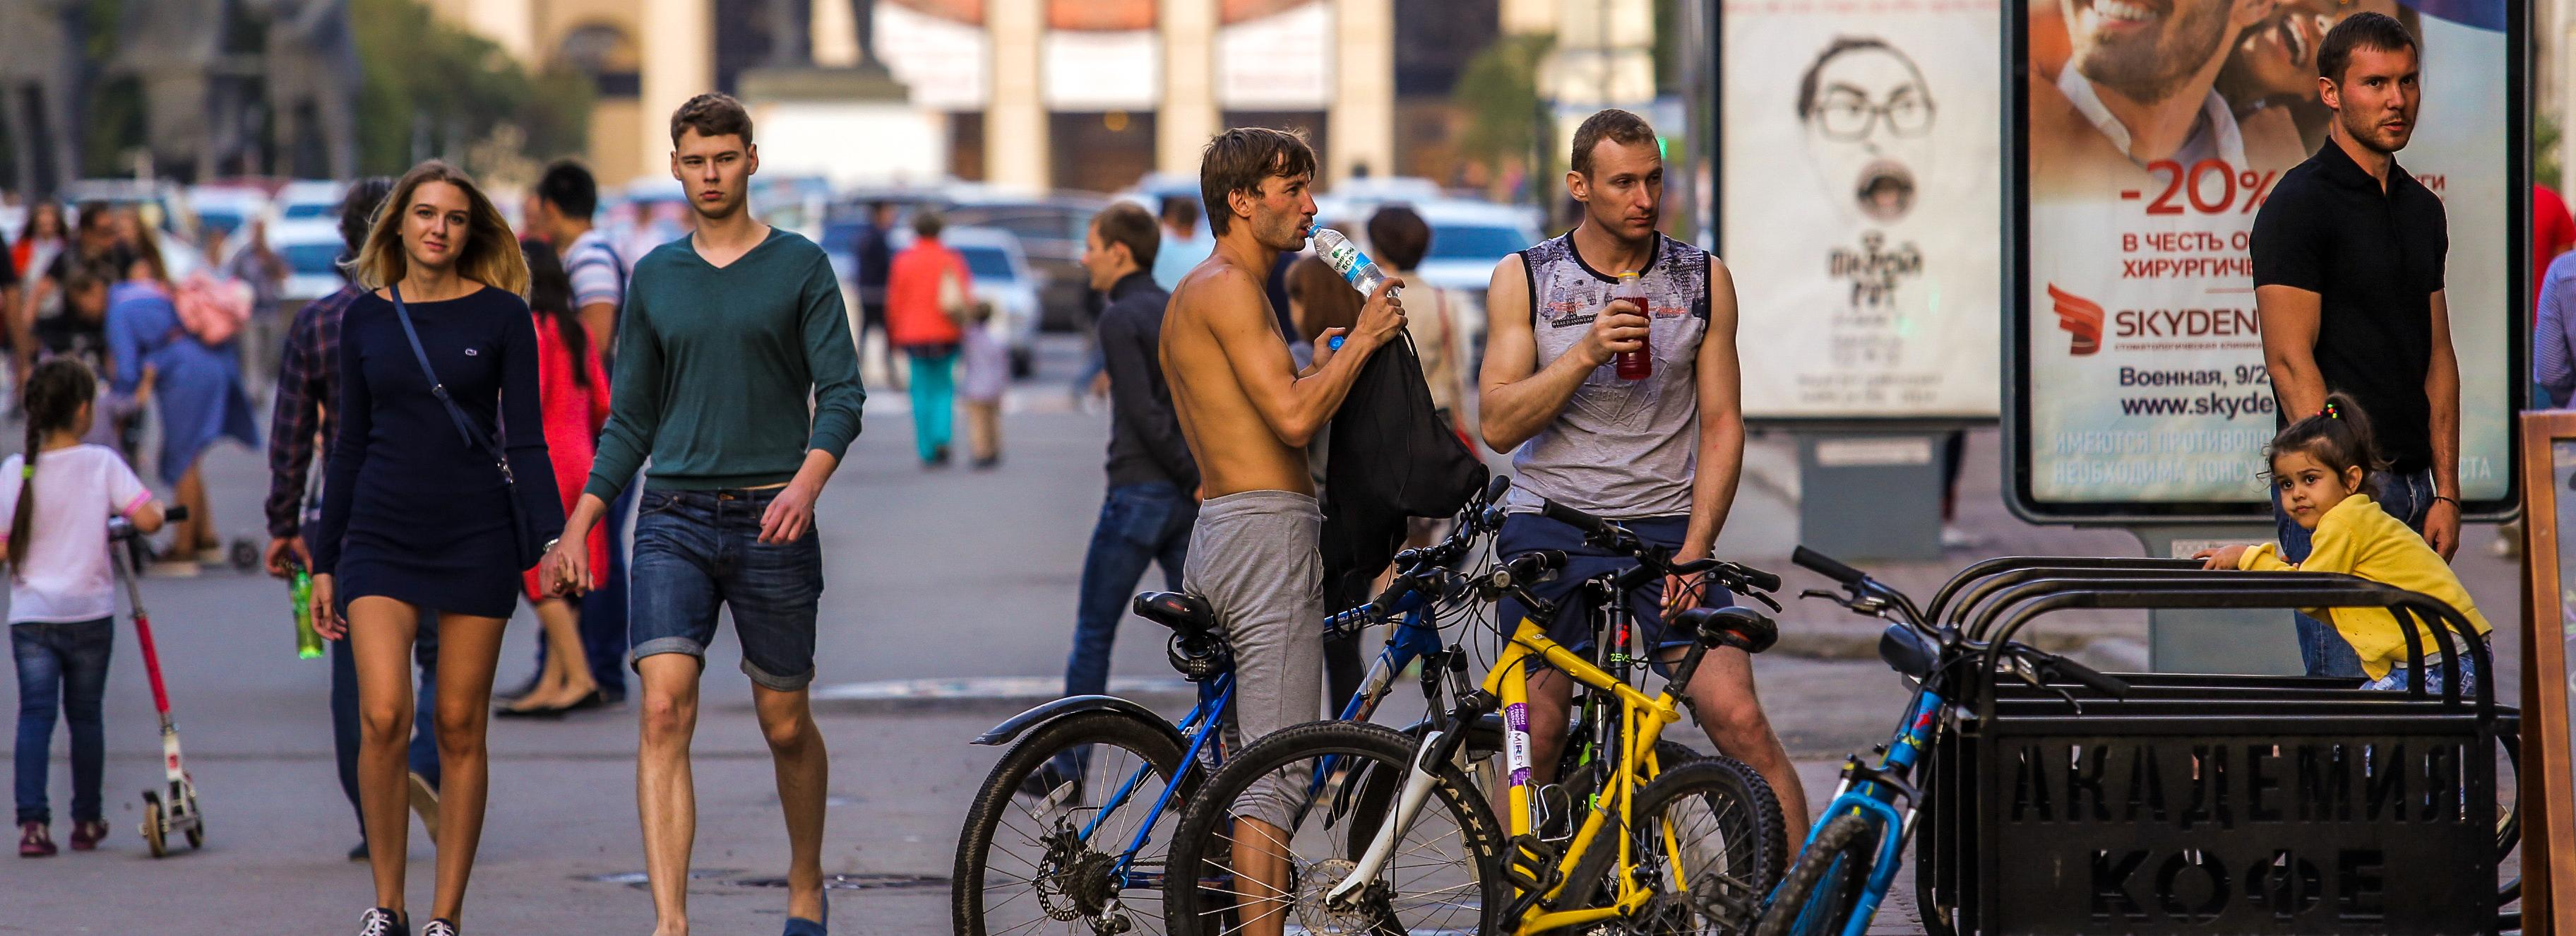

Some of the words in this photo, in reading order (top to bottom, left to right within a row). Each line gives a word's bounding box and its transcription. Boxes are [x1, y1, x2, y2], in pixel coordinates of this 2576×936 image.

[2123, 233, 2138, 251] В
[2147, 232, 2223, 251] ЧЕСТЬ
[1342, 256, 1354, 271] БОР
[2116, 308, 2258, 337] SKYDEN
[2120, 367, 2228, 387] Военная,
[2121, 391, 2273, 420] www.skyde
[2158, 429, 2271, 454] ПРОТИВОПО
[2010, 744, 2466, 831] АКАДЕМИЯ
[1439, 776, 1493, 857] AXXIS
[2091, 848, 2385, 925] КОФЕ
